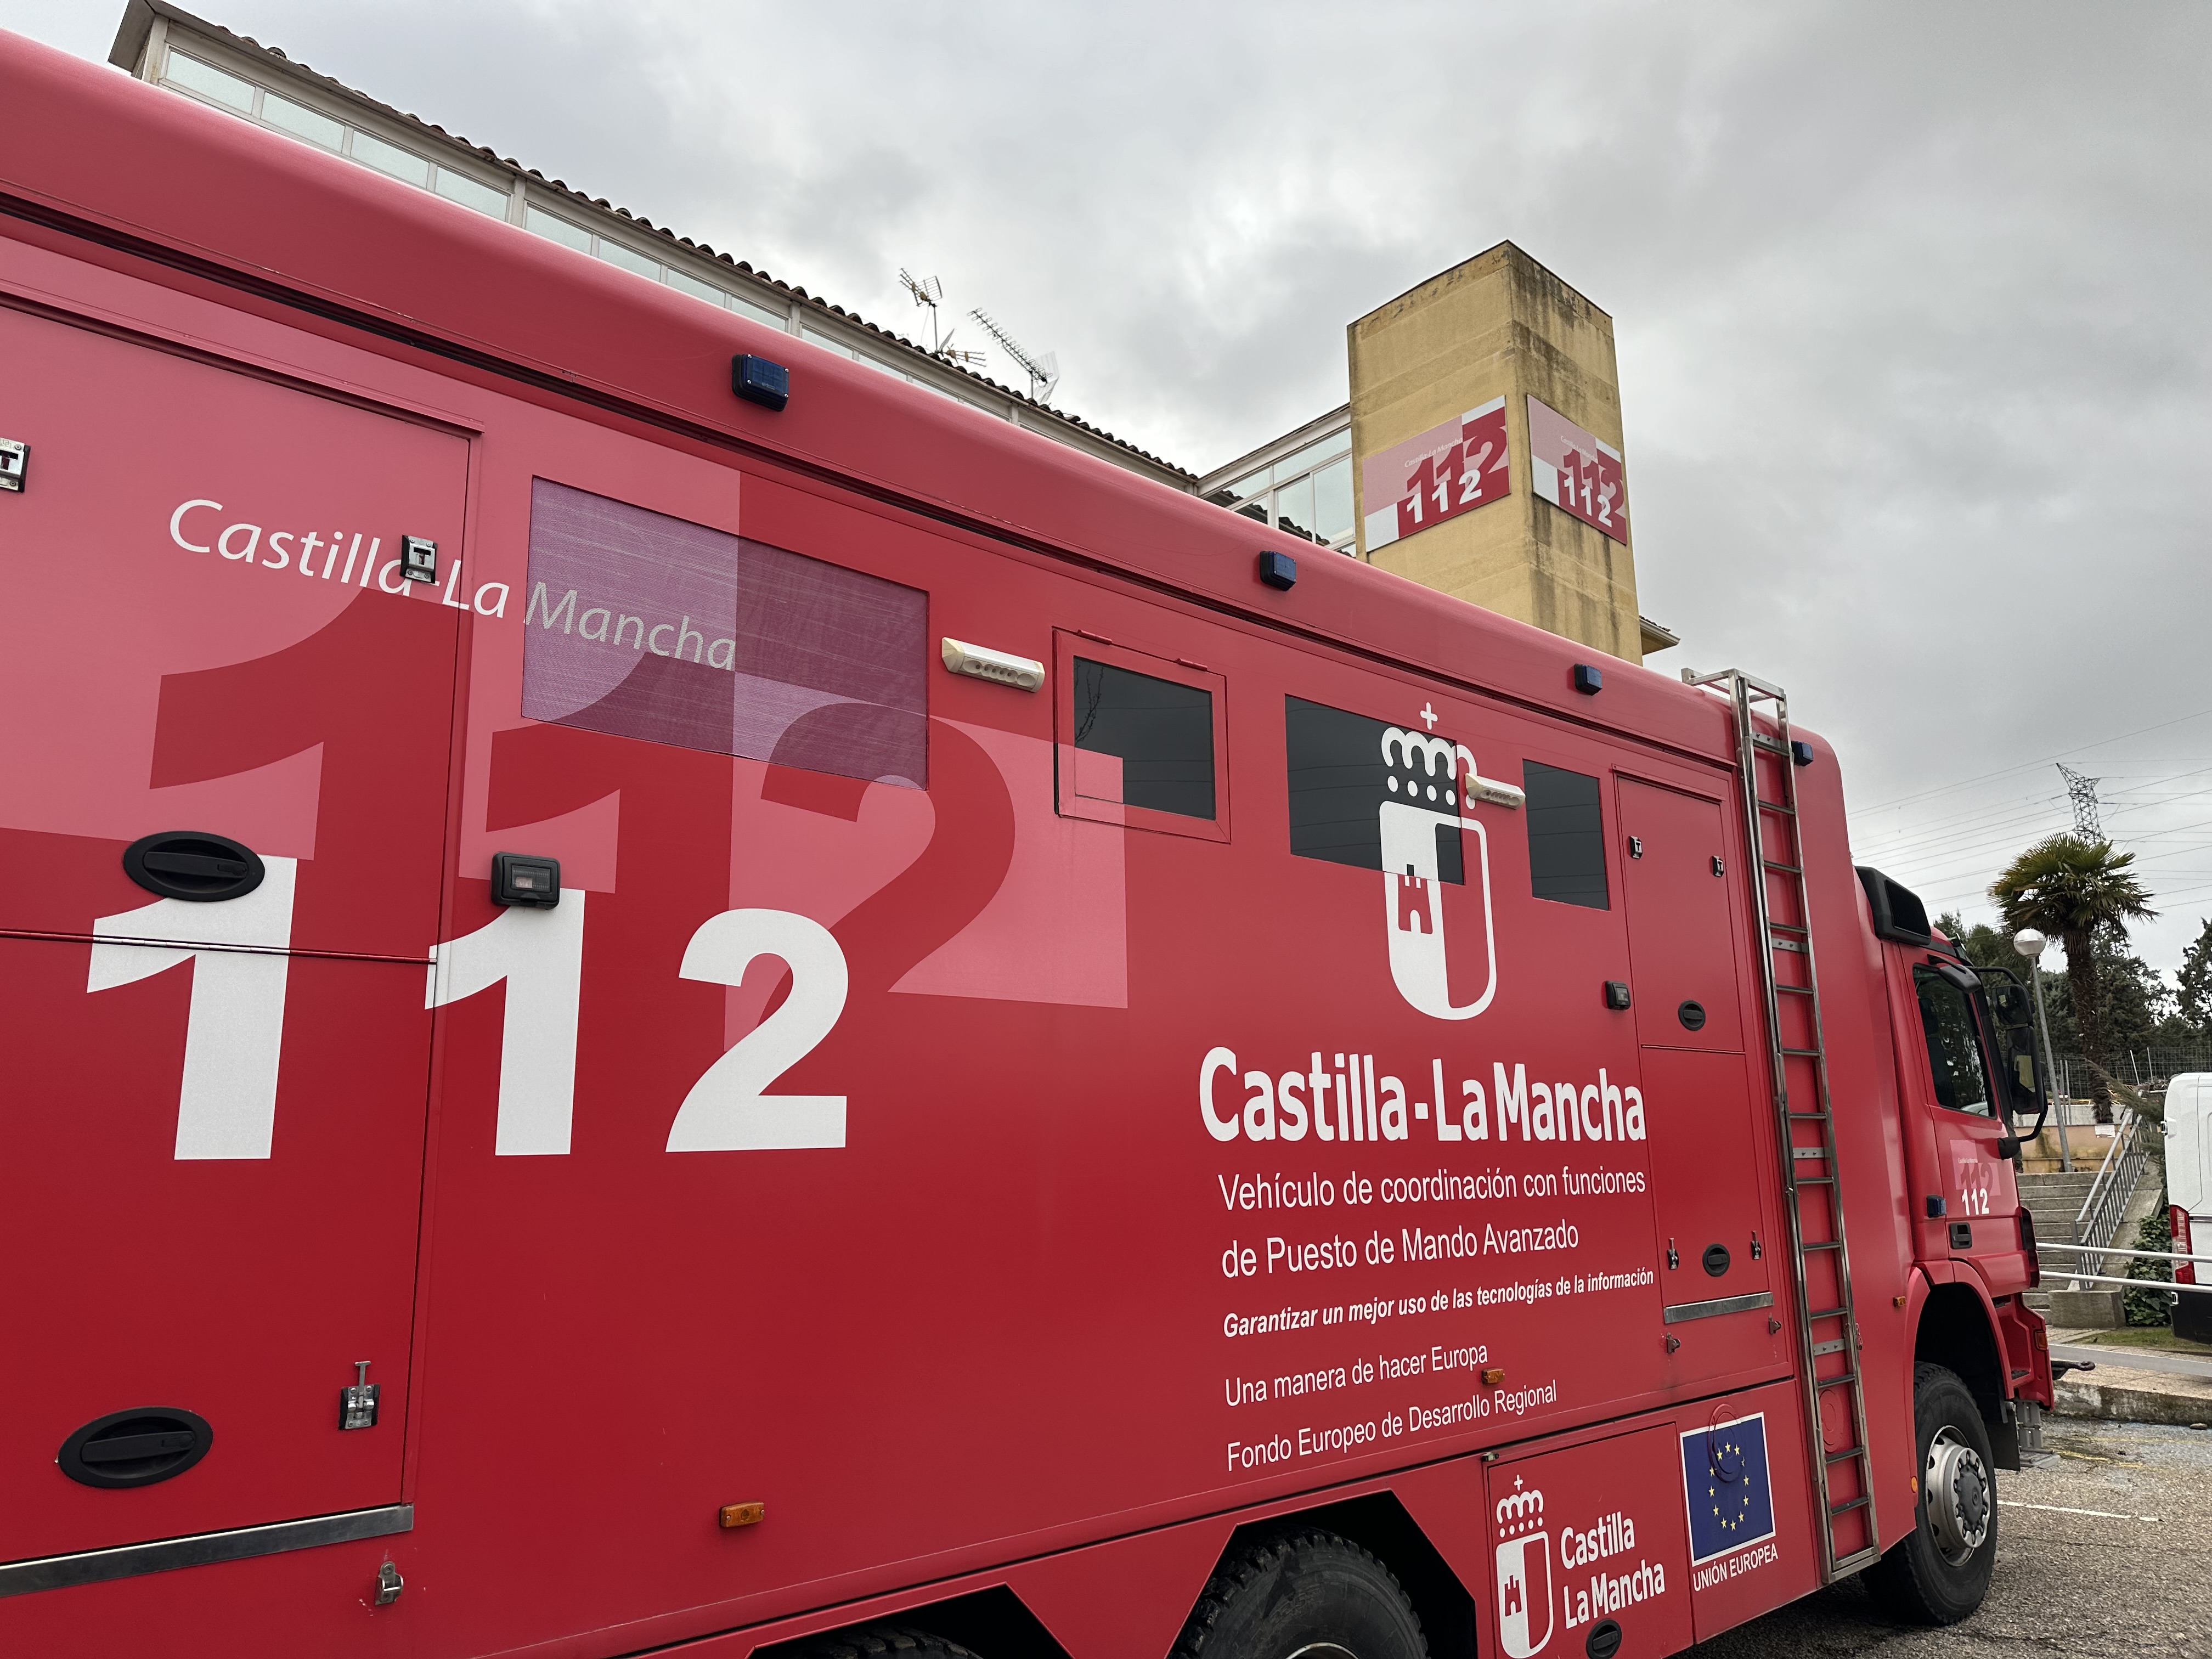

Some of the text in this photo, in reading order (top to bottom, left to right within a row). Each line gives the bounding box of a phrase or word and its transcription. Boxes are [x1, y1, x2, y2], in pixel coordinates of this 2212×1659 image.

[1406, 469, 1482, 524] 112
[1564, 476, 1612, 528] 112
[523, 581, 736, 672] Mancha
[86, 854, 849, 1160] 112
[1493, 1062, 1646, 1141] Mancha
[1217, 1165, 1645, 1210] Vehículo de coordinación con funciones
[1961, 1188, 1990, 1216] 112
[1222, 1218, 1578, 1278] de Puesto de Mando Avanzado
[1223, 1267, 1654, 1338] Garantizar un mejor uso de las tecnologías de la información
[1226, 1345, 1488, 1407] Una manera de hacer Europa
[1228, 1379, 1556, 1471] Fondo Europeo de Desarrollo Regional
[1561, 1511, 1635, 1570] Castilla
[1692, 1543, 1779, 1592] UNIÓN EUROPEA
[1564, 1559, 1665, 1629] La Mancha
